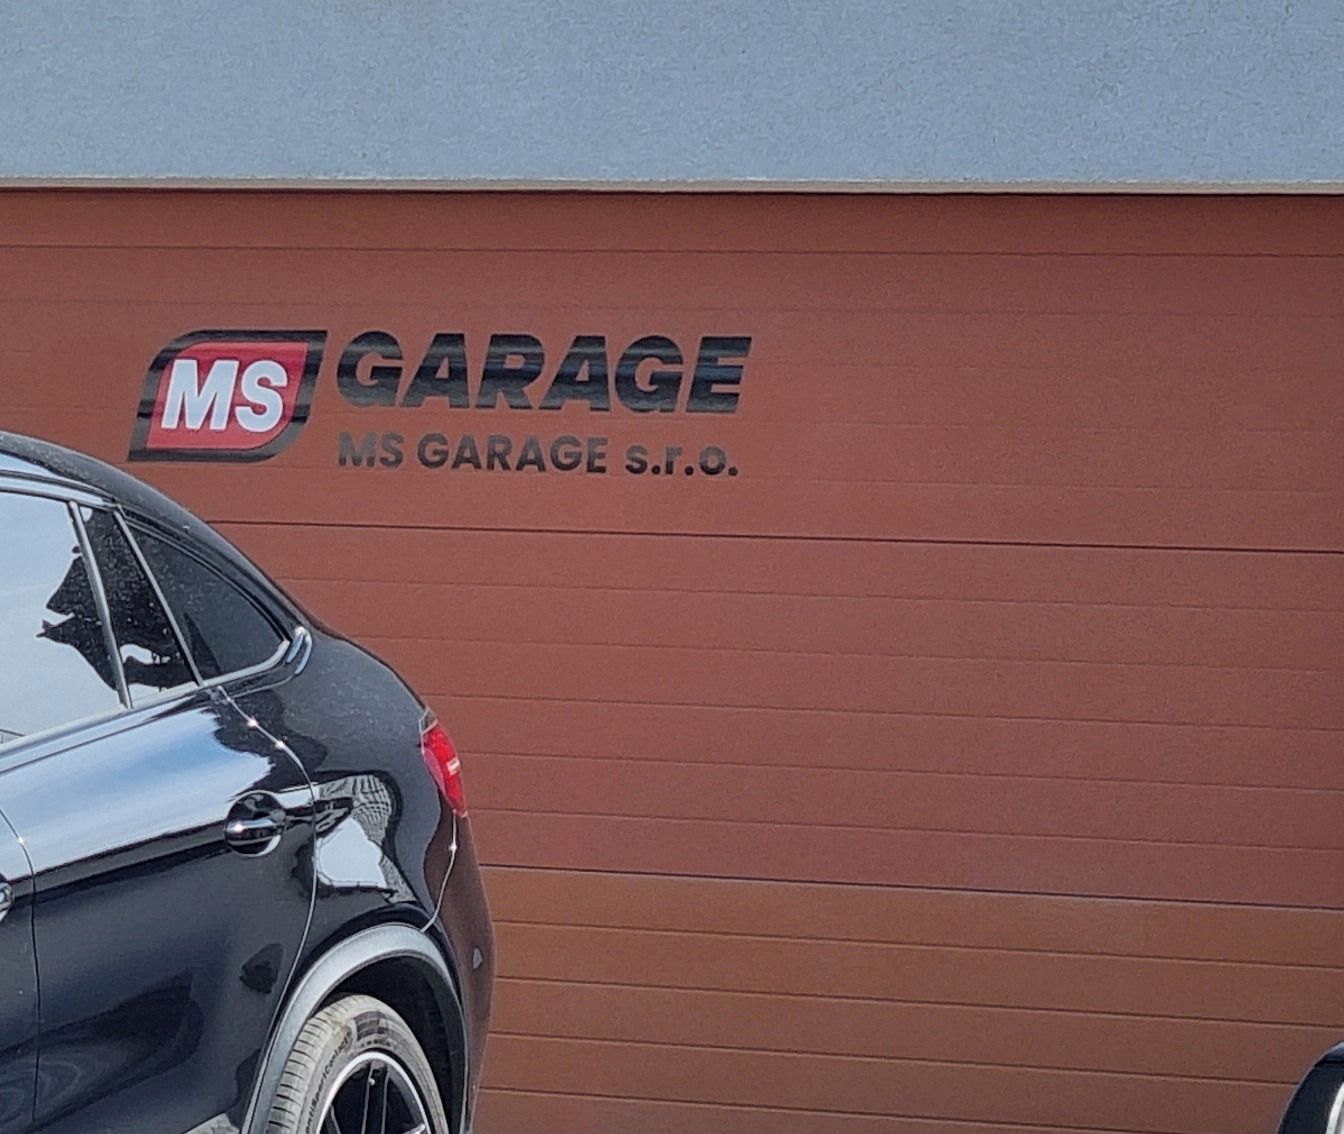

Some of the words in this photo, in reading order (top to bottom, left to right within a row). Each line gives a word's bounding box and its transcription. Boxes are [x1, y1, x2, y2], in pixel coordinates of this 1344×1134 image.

[161, 359, 287, 433] MS
[336, 330, 752, 414] GARAGE
[338, 433, 405, 469] MS
[417, 434, 608, 474] GARAGE
[625, 443, 739, 477] s.r.o.
